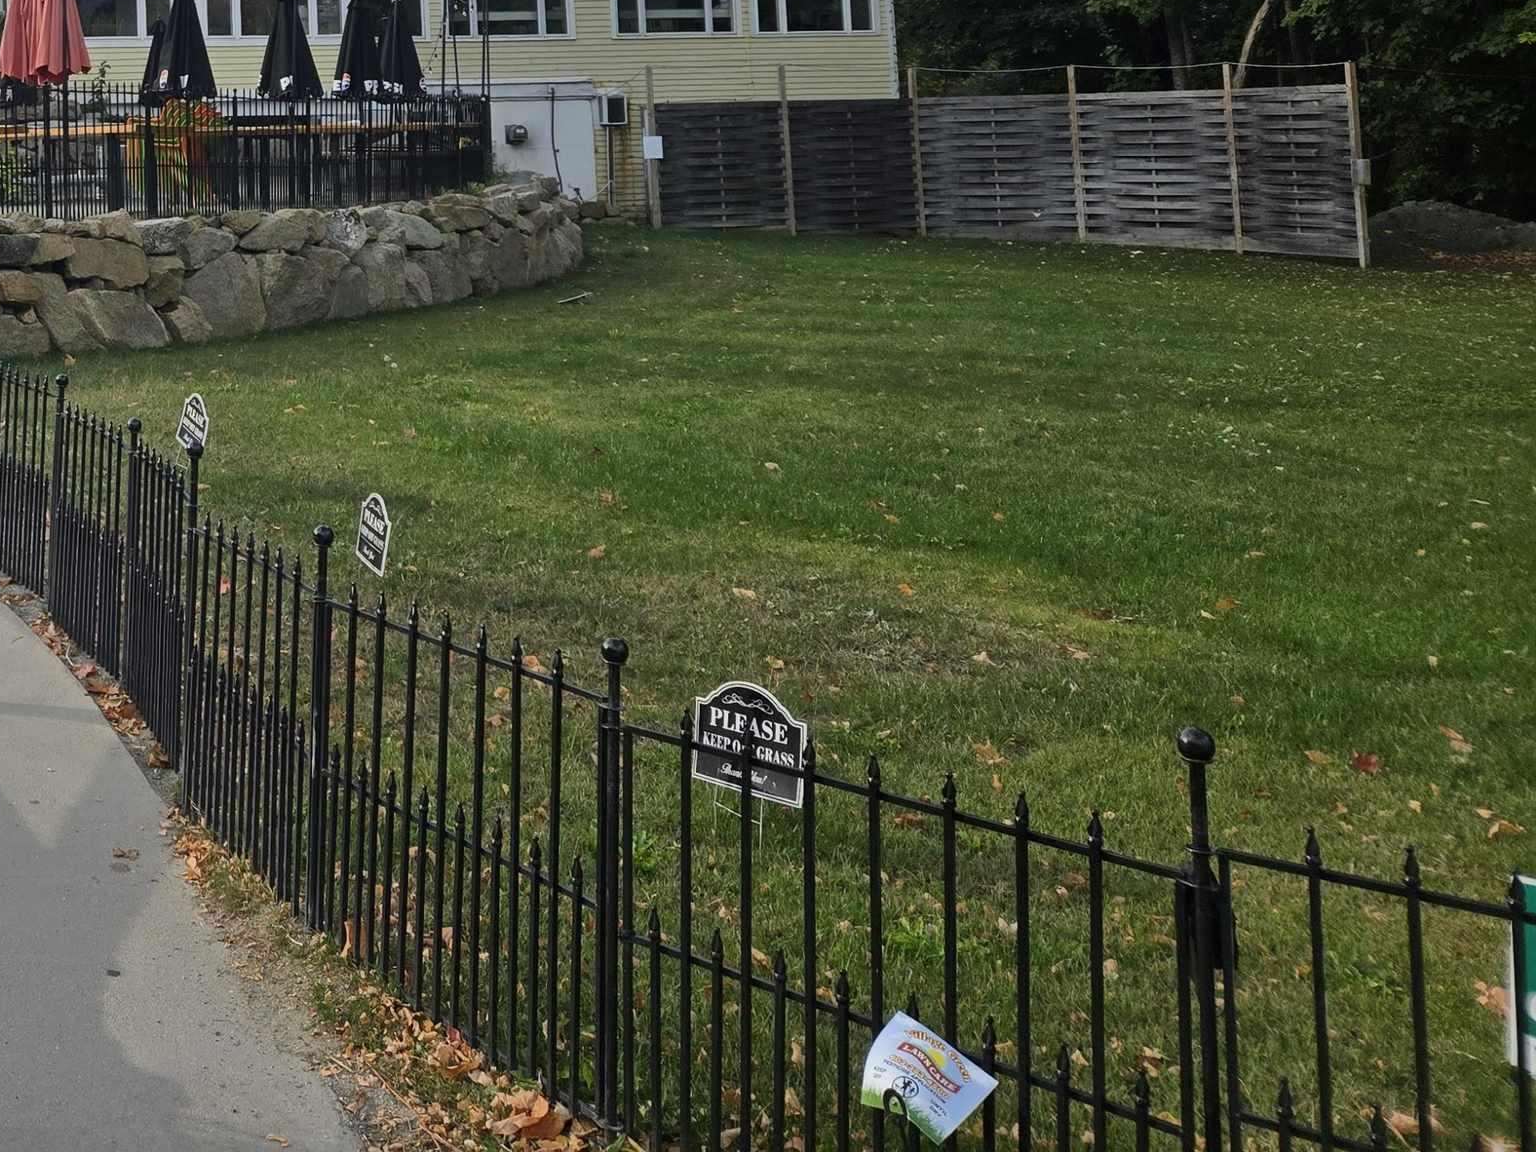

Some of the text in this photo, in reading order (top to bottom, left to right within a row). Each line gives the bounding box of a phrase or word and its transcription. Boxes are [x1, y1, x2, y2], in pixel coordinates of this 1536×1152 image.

[709, 706, 789, 745] PLEASE
[703, 731, 731, 751] KEEP
[756, 745, 794, 767] GRASS
[720, 762, 743, 779] Than
[902, 1043, 932, 1068] LAWN
[929, 1067, 958, 1093] CARE
